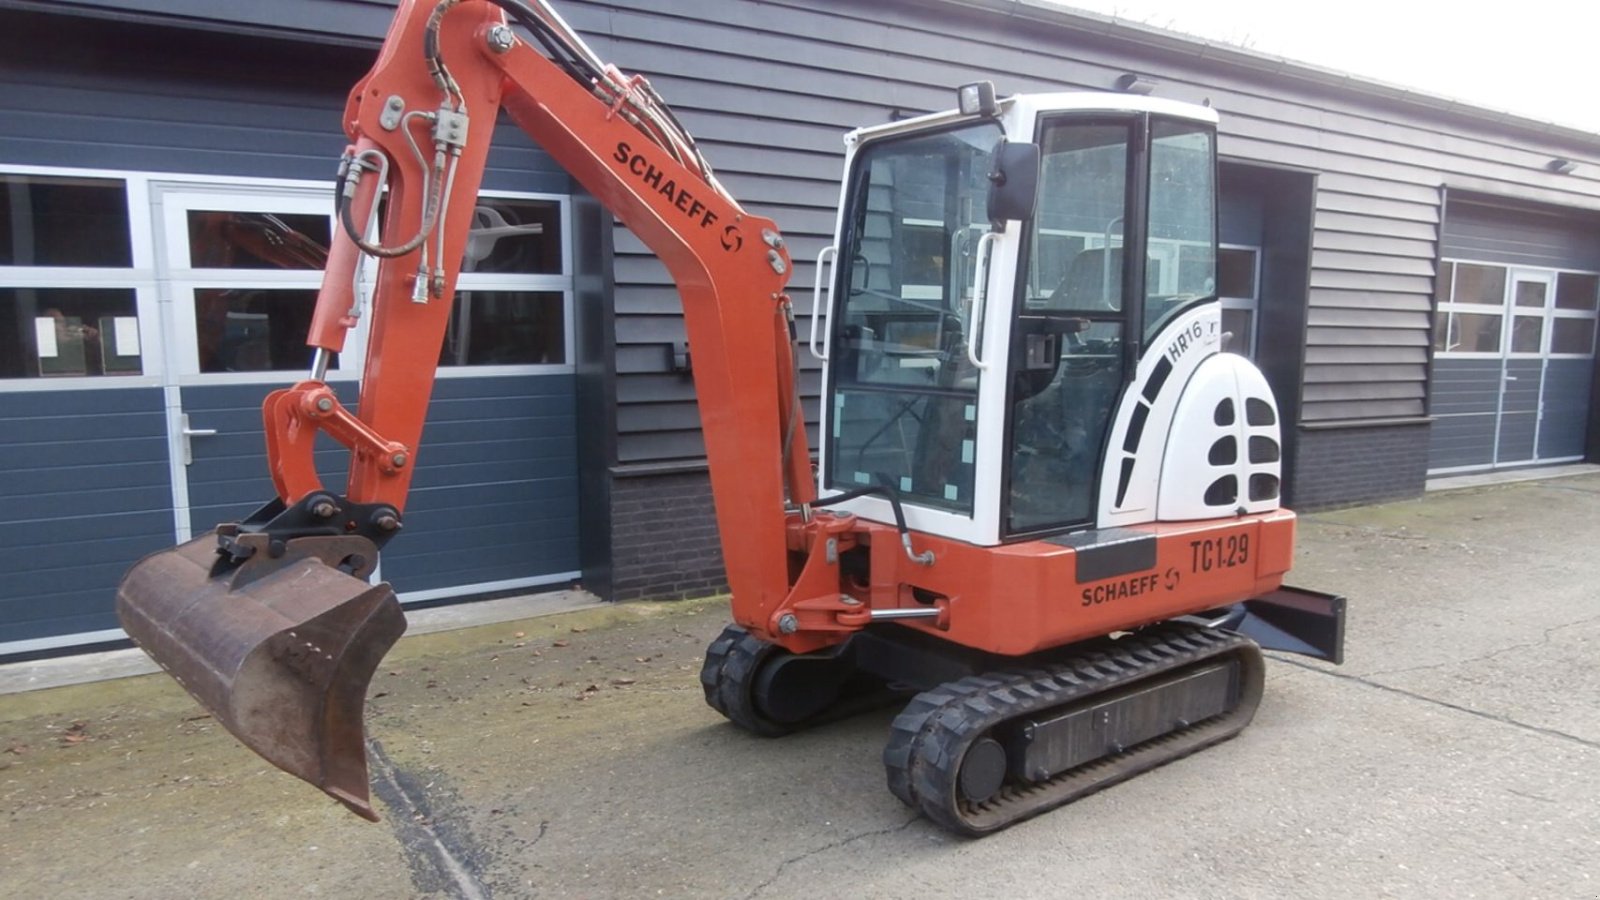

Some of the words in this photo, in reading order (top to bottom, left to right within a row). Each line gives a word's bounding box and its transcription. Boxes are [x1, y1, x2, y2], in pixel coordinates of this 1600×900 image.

[613, 142, 718, 228] SCHAEFF
[1168, 321, 1202, 362] HR16
[1190, 533, 1249, 573] TC1.29
[1082, 574, 1159, 607] SCHAEFF
